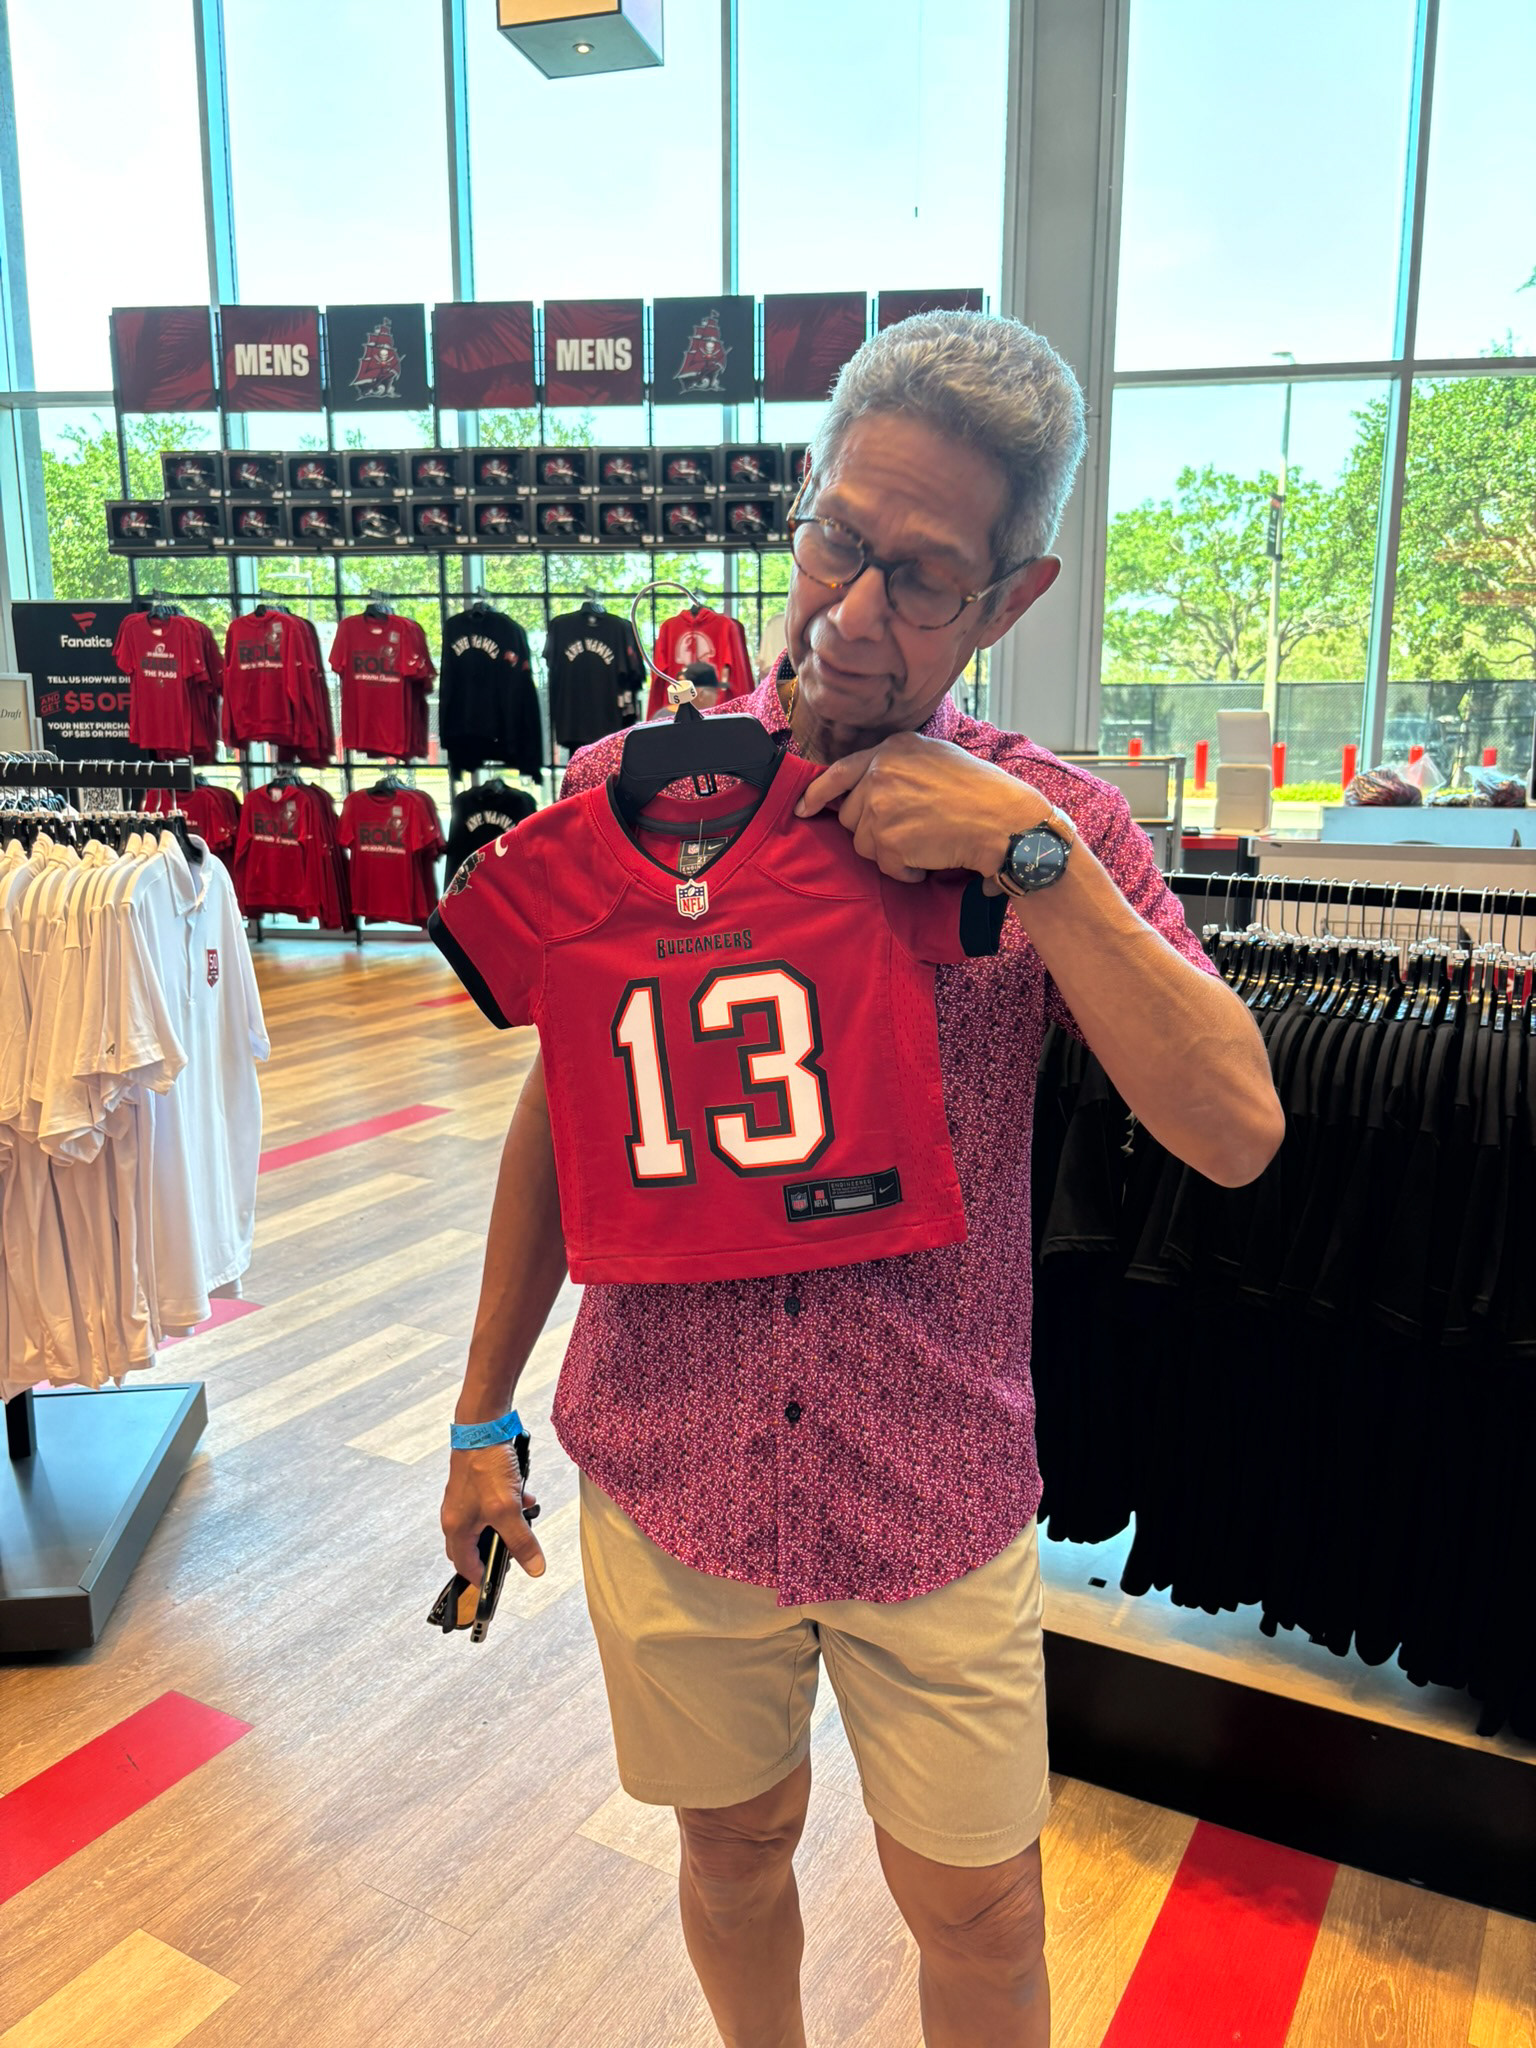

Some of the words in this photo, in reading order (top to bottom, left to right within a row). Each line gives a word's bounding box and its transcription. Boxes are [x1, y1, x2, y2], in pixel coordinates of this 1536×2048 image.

[234, 343, 311, 377] MENS
[556, 337, 633, 372] MENS
[60, 634, 114, 648] Fanatics
[47, 675, 69, 685] TELL
[68, 675, 81, 685] US
[81, 675, 103, 685] HOW
[102, 675, 118, 685] WE
[144, 669, 157, 678] THE
[64, 690, 96, 715] $5
[673, 694, 680, 704] S
[41, 702, 60, 714] GET
[48, 721, 72, 731] YOUR
[72, 721, 95, 731] NEXT
[95, 721, 131, 731] PURCHA
[61, 730, 74, 739] OF
[91, 730, 104, 739] OR
[104, 730, 131, 739] MORE
[682, 897, 704, 914] NFL
[656, 928, 753, 960] BUCCANEERS
[610, 959, 836, 1188] 13
